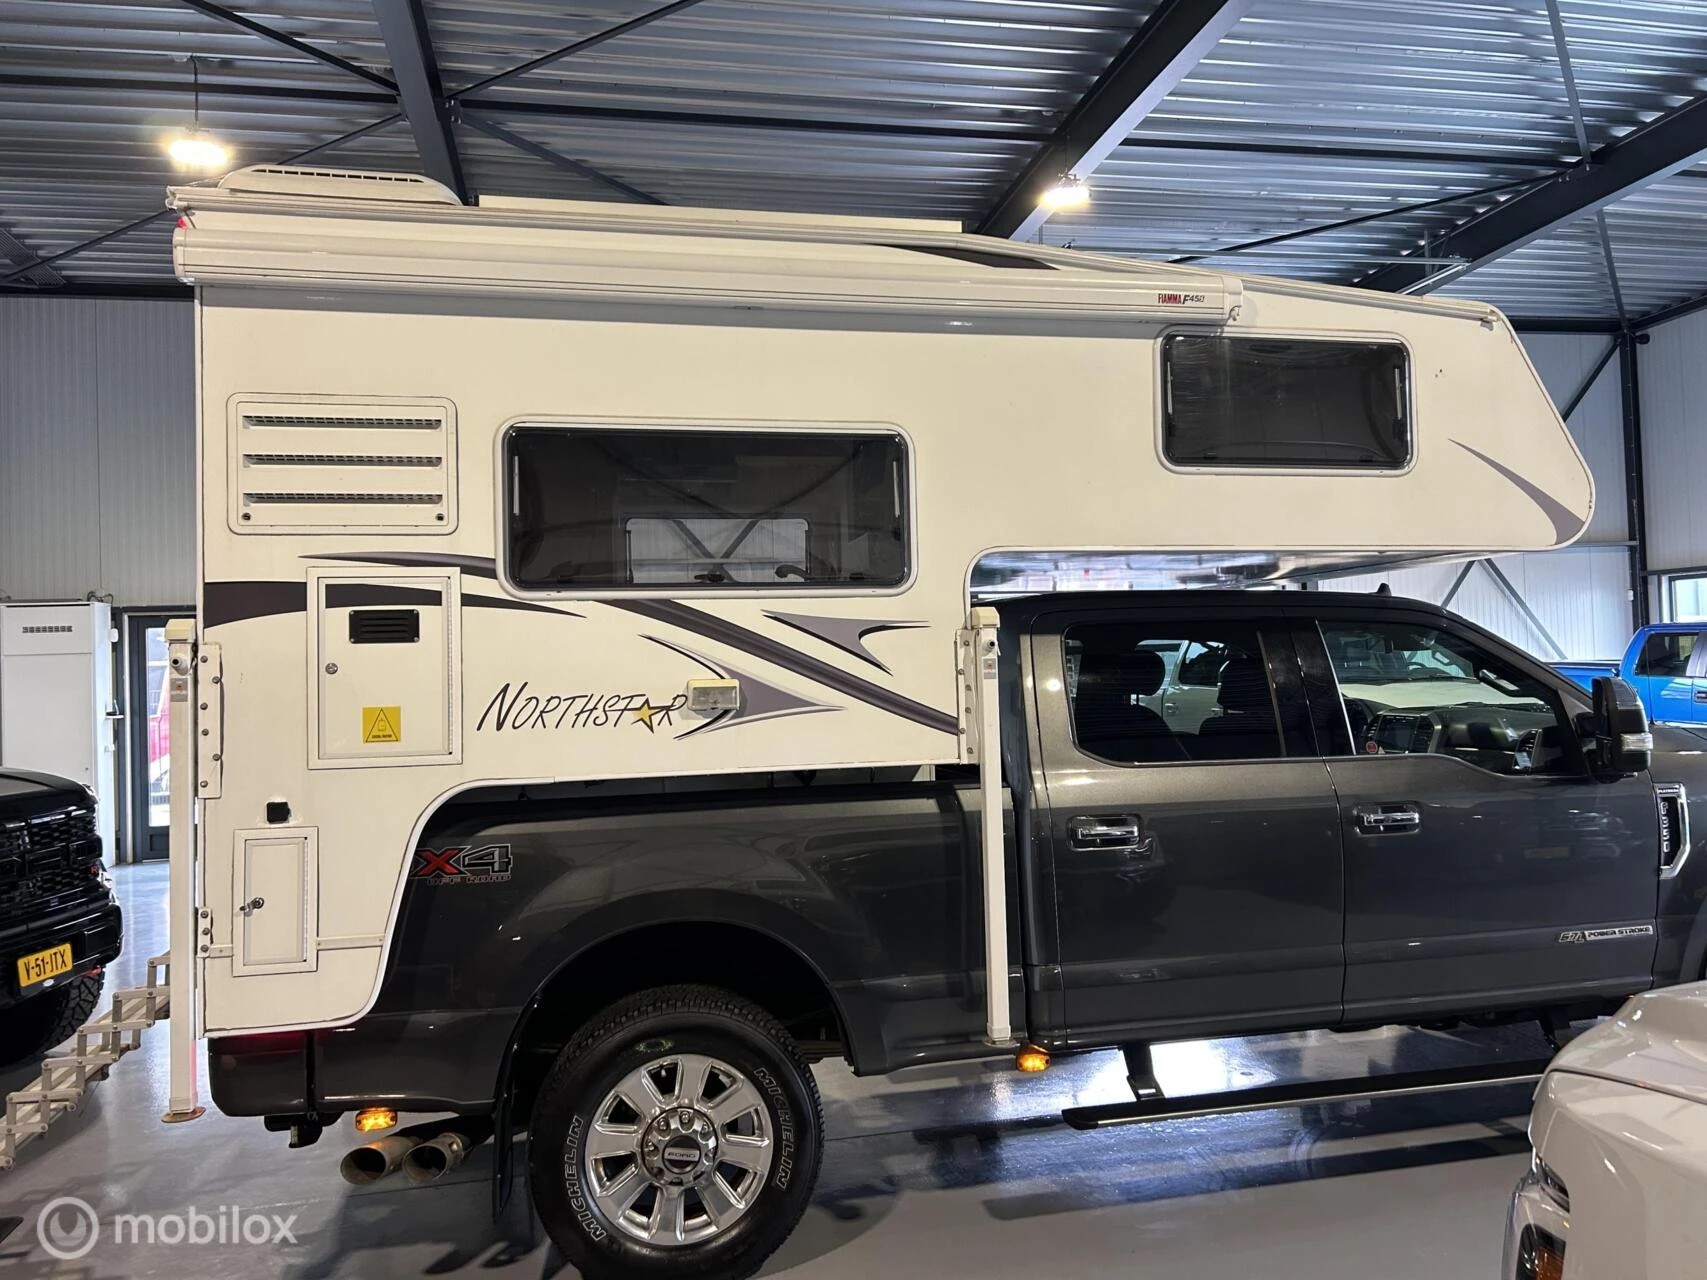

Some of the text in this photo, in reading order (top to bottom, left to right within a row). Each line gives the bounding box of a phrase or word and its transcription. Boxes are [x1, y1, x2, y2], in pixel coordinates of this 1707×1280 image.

[1158, 293, 1181, 304] FIAMMA
[24, 949, 67, 981] V-51-JTX
[753, 1067, 794, 1192] MICHELIN
[564, 1114, 607, 1241] MICHELIN
